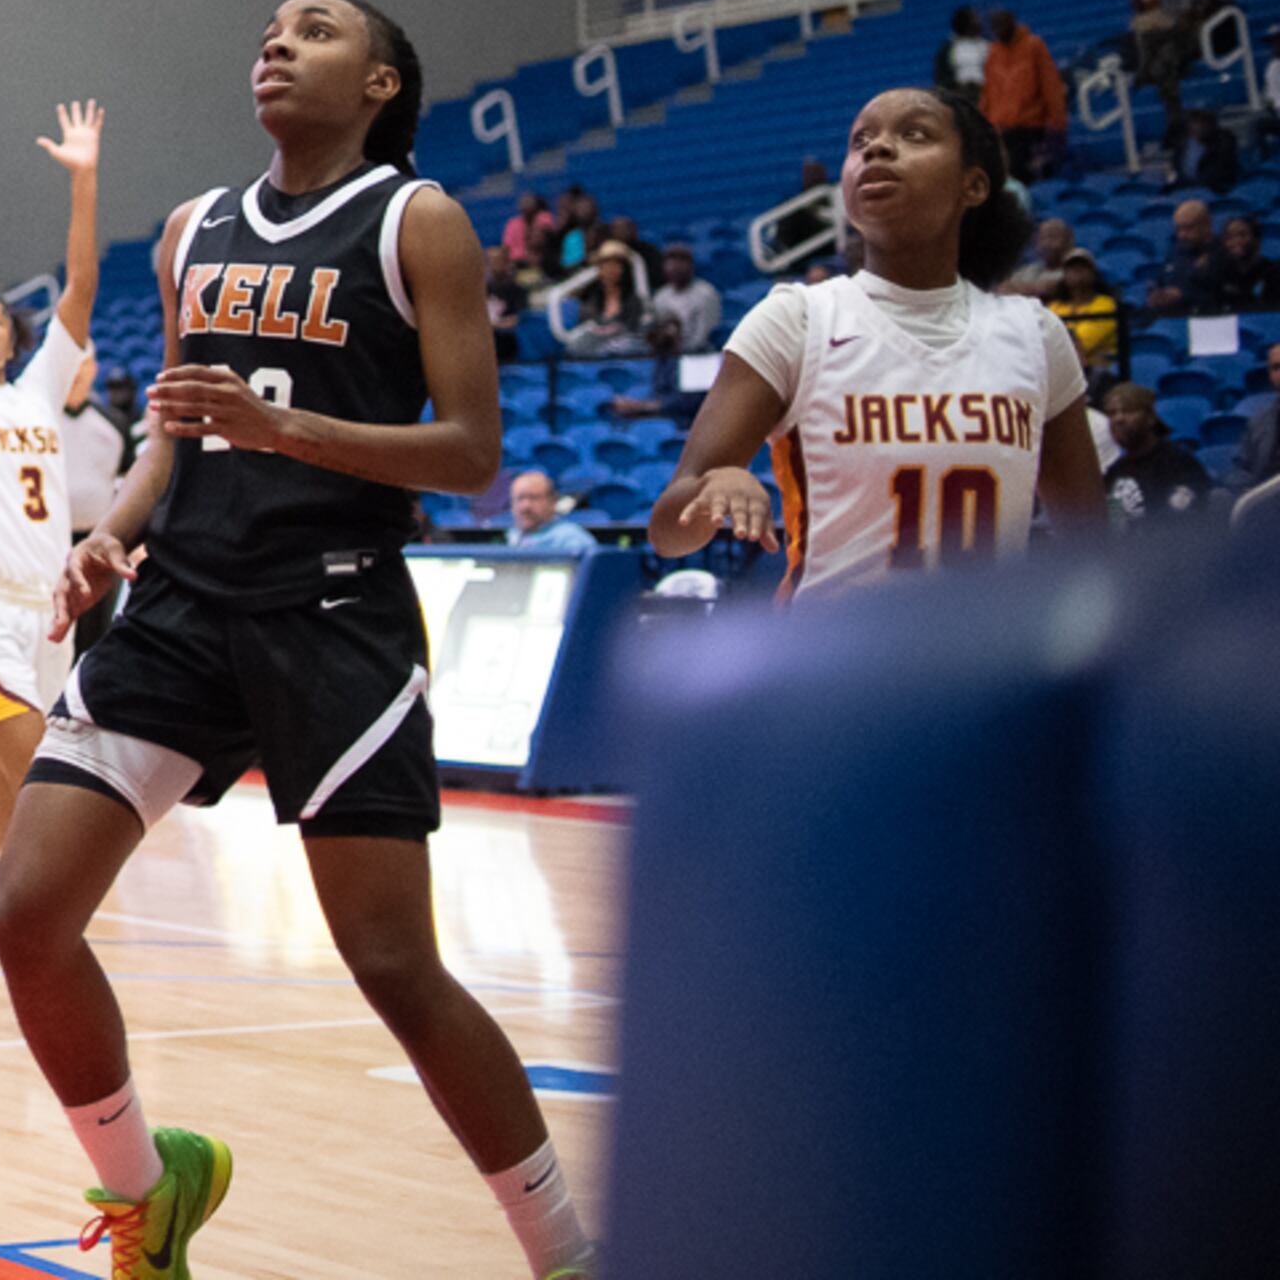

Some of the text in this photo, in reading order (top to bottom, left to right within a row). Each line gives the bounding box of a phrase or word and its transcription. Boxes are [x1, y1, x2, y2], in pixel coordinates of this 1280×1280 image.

[178, 262, 350, 348] KELL
[833, 392, 1033, 453] JACKSON
[18, 464, 50, 523] 3
[886, 463, 1001, 570] 10
